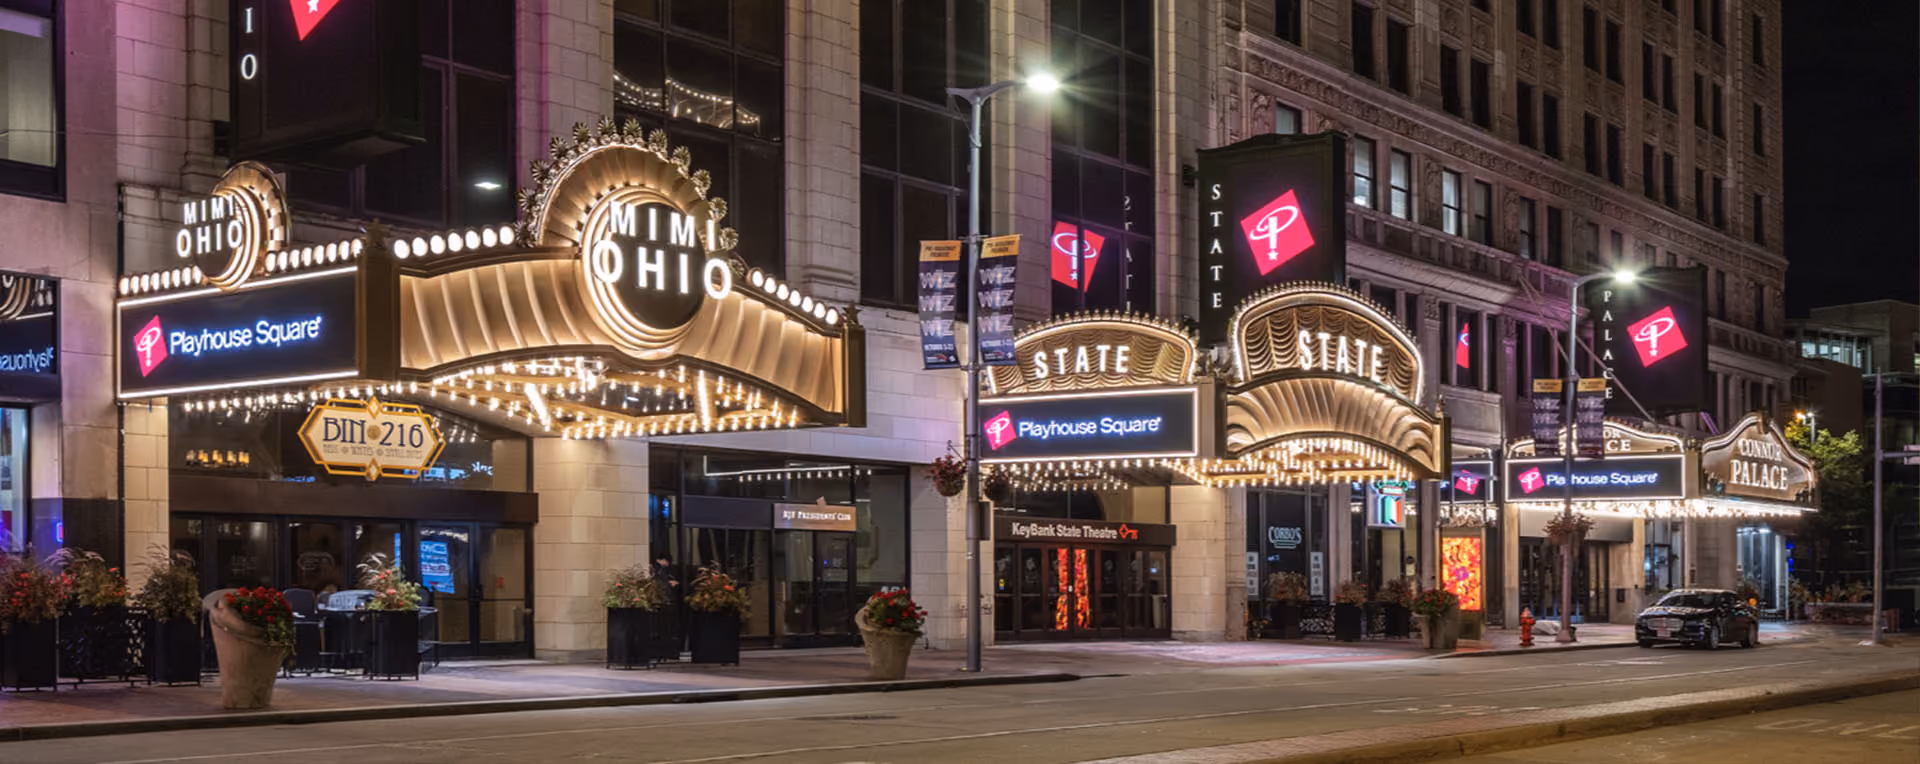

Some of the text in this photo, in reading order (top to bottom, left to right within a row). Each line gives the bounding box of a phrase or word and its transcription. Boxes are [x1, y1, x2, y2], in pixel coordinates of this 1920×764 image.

[184, 195, 234, 225] MIMI
[176, 219, 242, 258] OHIO
[609, 200, 716, 251] MIMI
[1210, 184, 1223, 308] STATE
[592, 240, 732, 300] OHIO
[919, 271, 957, 289] WIZ
[979, 266, 1016, 286] WIZ
[919, 294, 955, 312] WIZ
[978, 289, 1014, 308] WIZ
[169, 318, 320, 357] Playhouse Square
[920, 319, 954, 337] WIZ
[978, 314, 1013, 334] WIZ
[1300, 329, 1383, 382] STATE
[1602, 290, 1614, 399] PALACE
[1034, 345, 1130, 379] STATE
[323, 416, 424, 449] BIN 216
[1018, 417, 1160, 439] Playhouse Square
[1738, 438, 1782, 461] CONNOR
[1546, 472, 1657, 488] Plahouse Square
[1730, 459, 1789, 490] PALACE
[1012, 522, 1118, 539] KeyBank State Theatre
